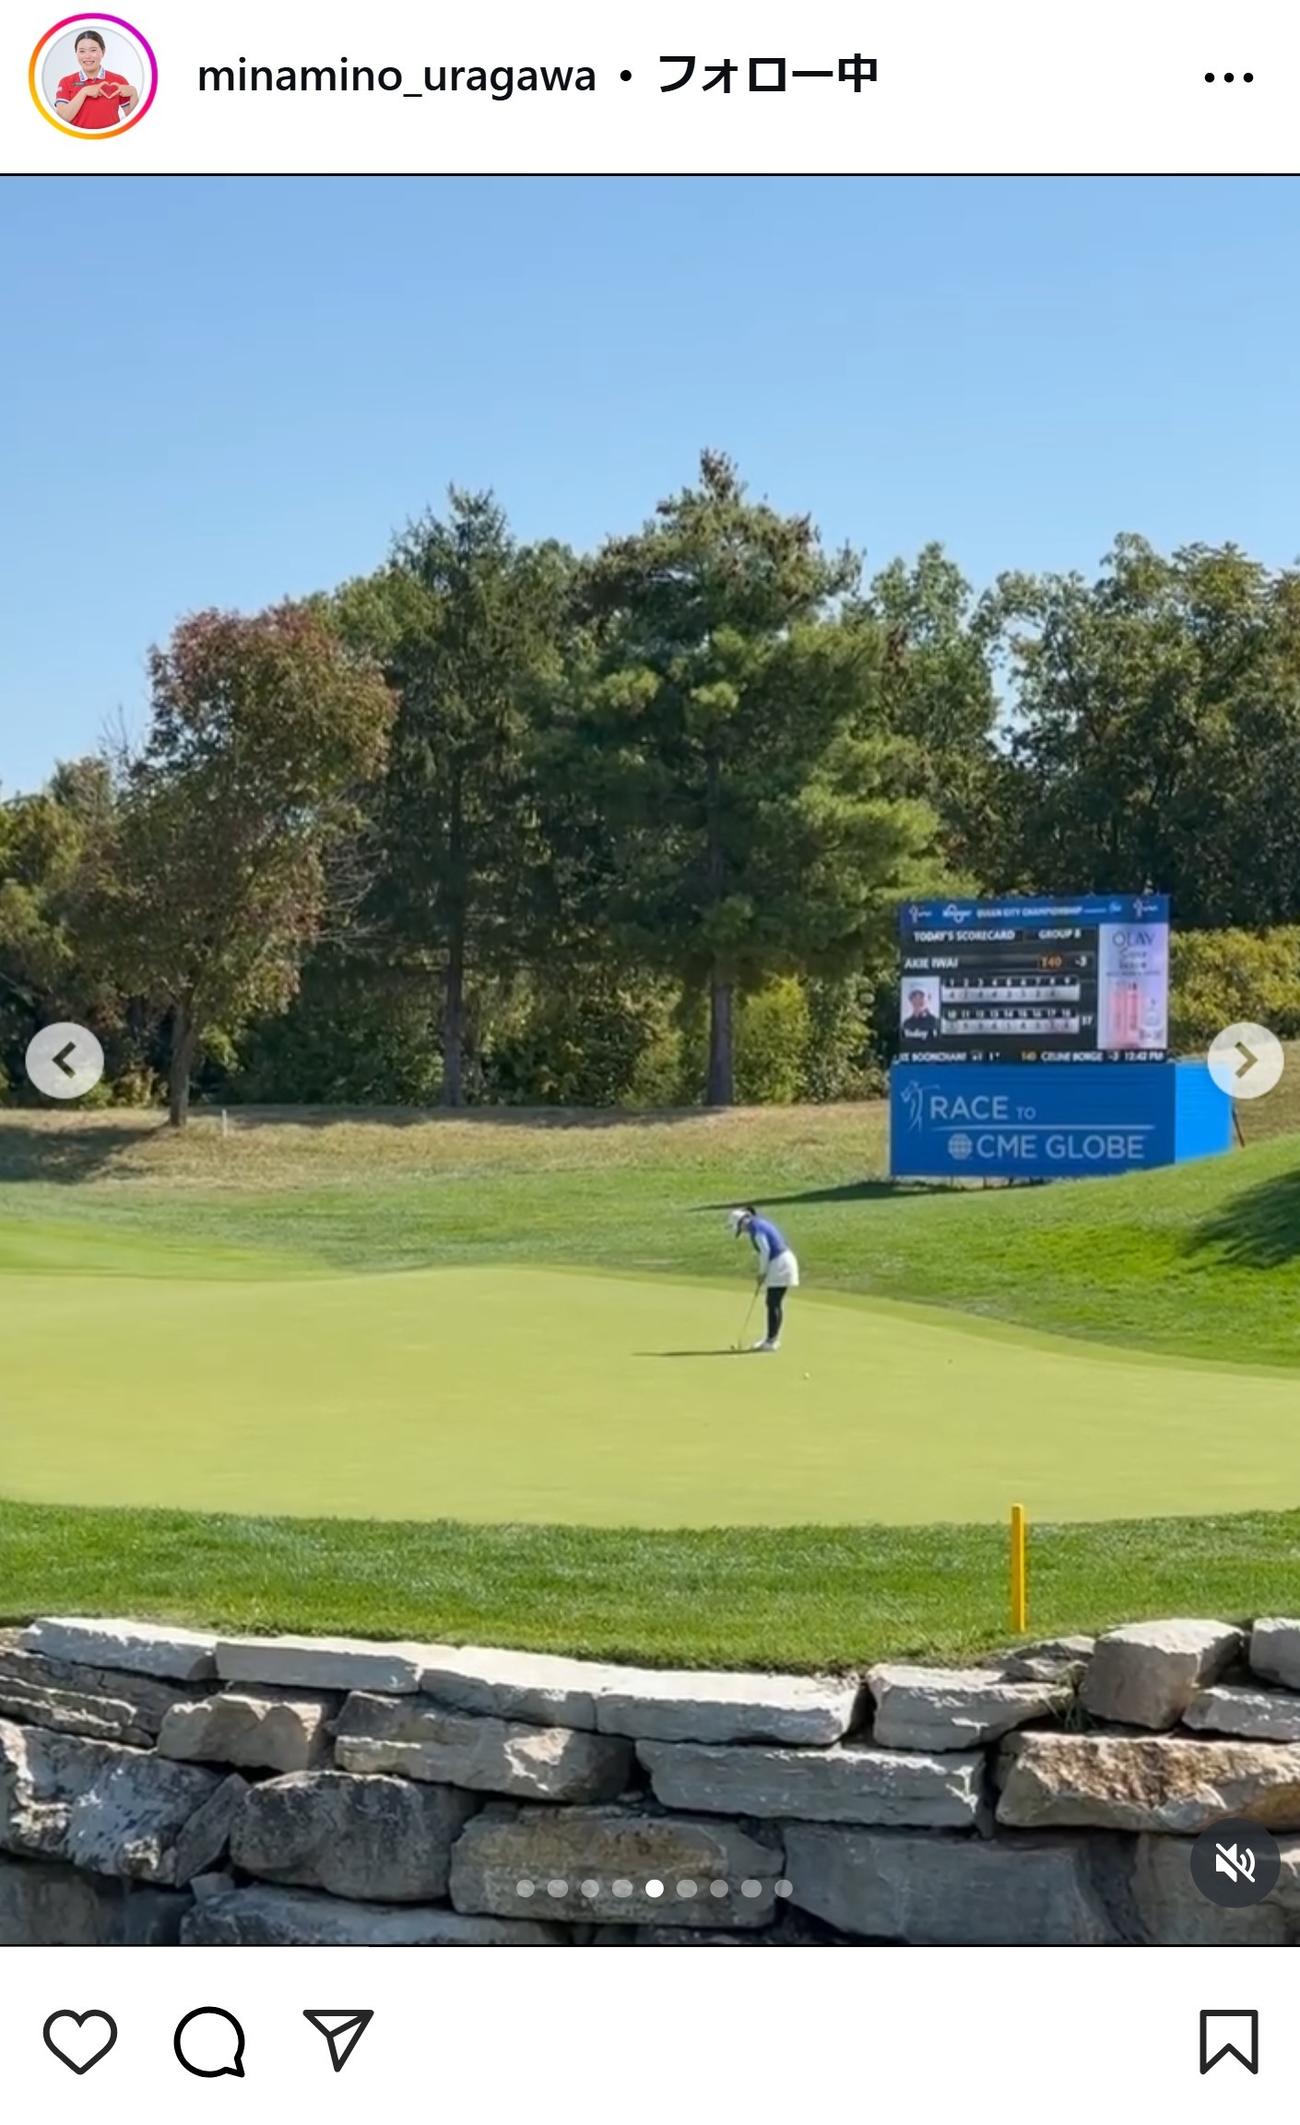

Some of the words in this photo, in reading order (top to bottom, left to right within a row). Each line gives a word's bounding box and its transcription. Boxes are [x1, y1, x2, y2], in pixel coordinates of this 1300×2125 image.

[1003, 907, 1020, 917] CITY
[914, 930, 954, 942] TODAY'S
[956, 929, 1016, 941] SCORECARD
[1039, 928, 1072, 940] GROUP
[1112, 930, 1155, 948] OLAY
[904, 957, 930, 969] AKIE
[931, 956, 960, 969] IWAI
[930, 1096, 1010, 1121] RACE
[1015, 1106, 1037, 1121] TO
[976, 1134, 1038, 1160] CME
[1045, 1134, 1146, 1160] GLOBE
